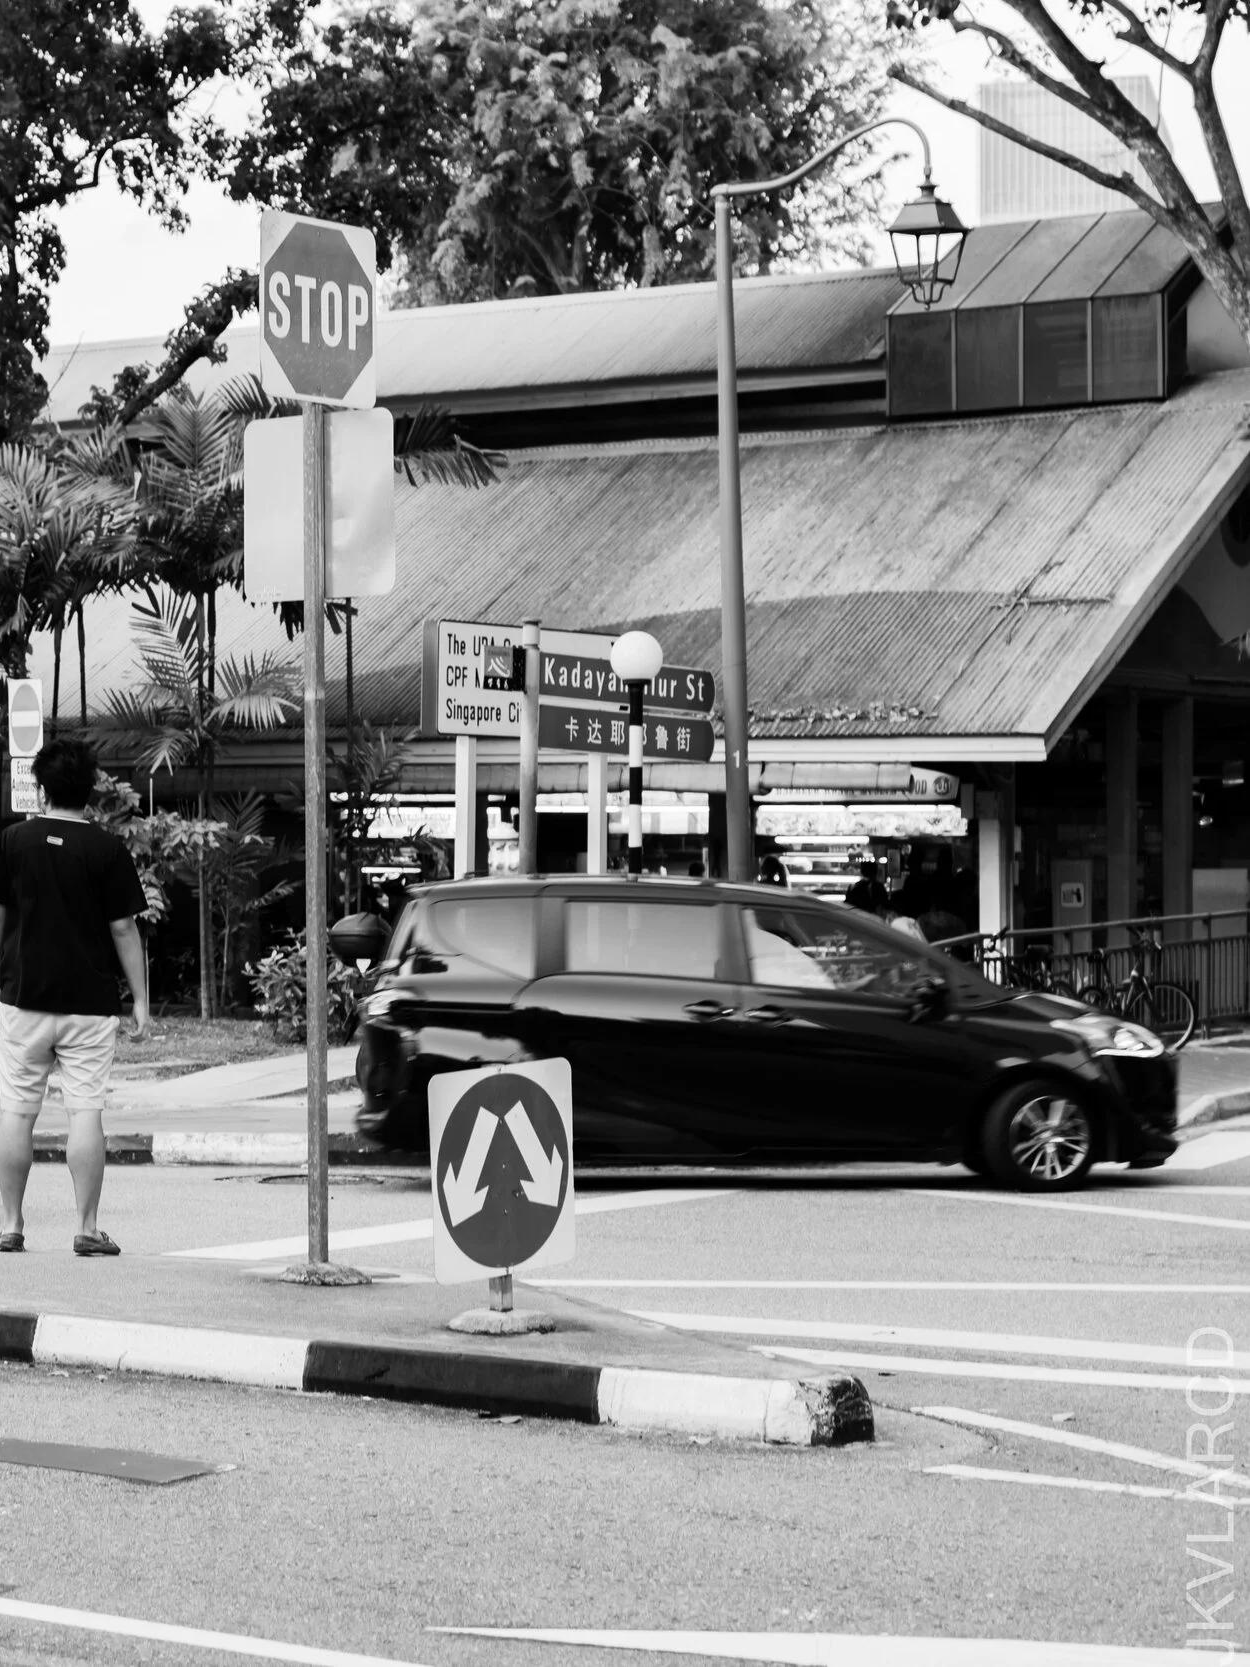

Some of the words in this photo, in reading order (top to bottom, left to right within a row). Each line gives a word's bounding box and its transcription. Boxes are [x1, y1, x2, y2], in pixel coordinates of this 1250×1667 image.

[268, 271, 369, 351] STOP
[447, 633, 466, 655] The
[446, 665, 468, 687] CPF
[544, 657, 677, 698] Kadayalur
[686, 674, 704, 701] St
[446, 698, 502, 727] Singapore
[17, 761, 32, 775] Exce
